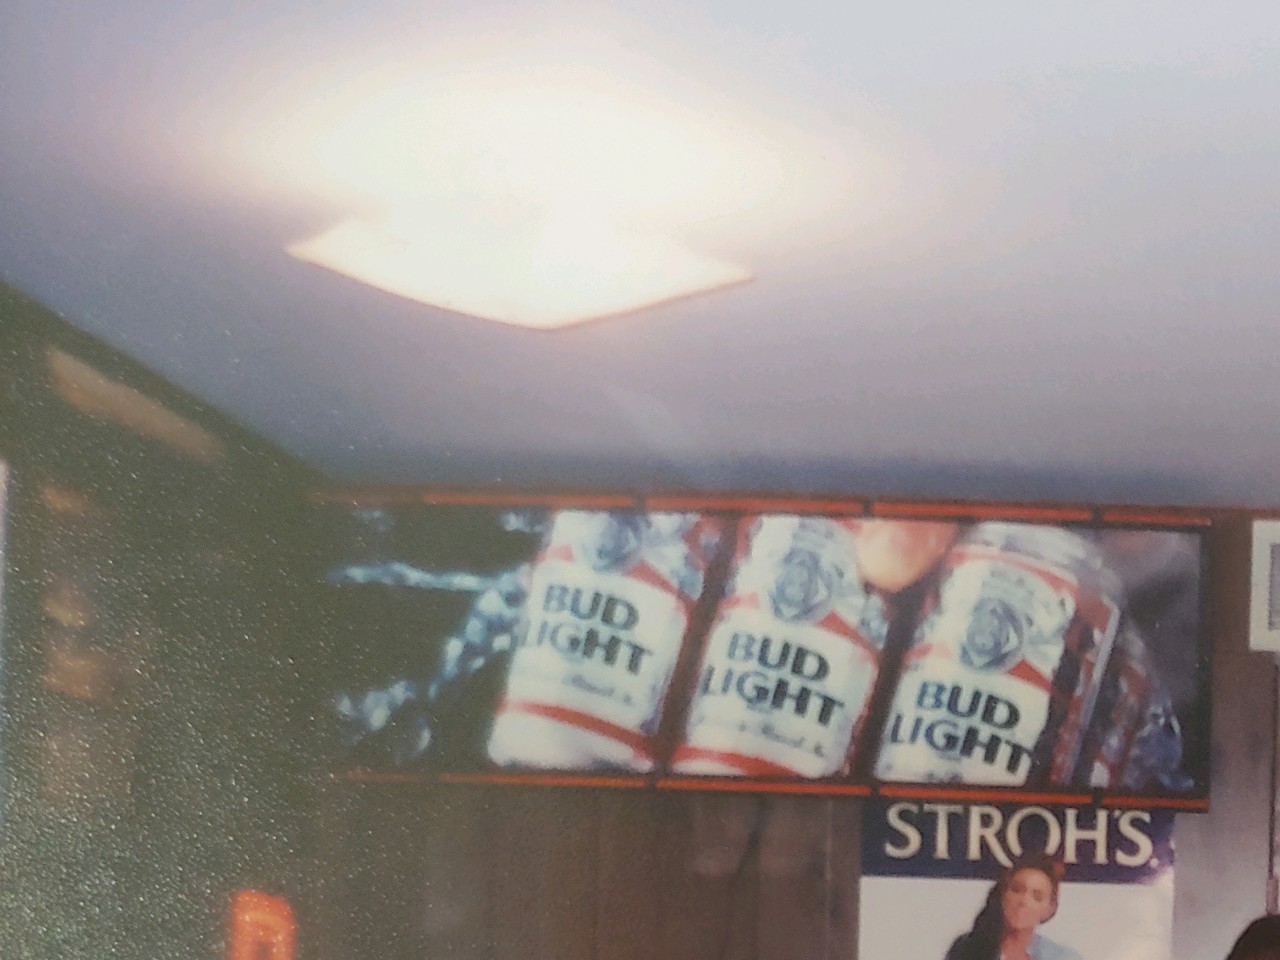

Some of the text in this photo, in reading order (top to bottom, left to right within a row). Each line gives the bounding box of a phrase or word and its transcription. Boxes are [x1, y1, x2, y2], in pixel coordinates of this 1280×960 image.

[543, 573, 640, 632] BUD
[727, 632, 831, 683] BUD
[699, 664, 846, 728] LIGHT
[916, 680, 1021, 730] BUD
[889, 712, 1032, 776] LIGHT
[884, 803, 1154, 867] STROH'S
